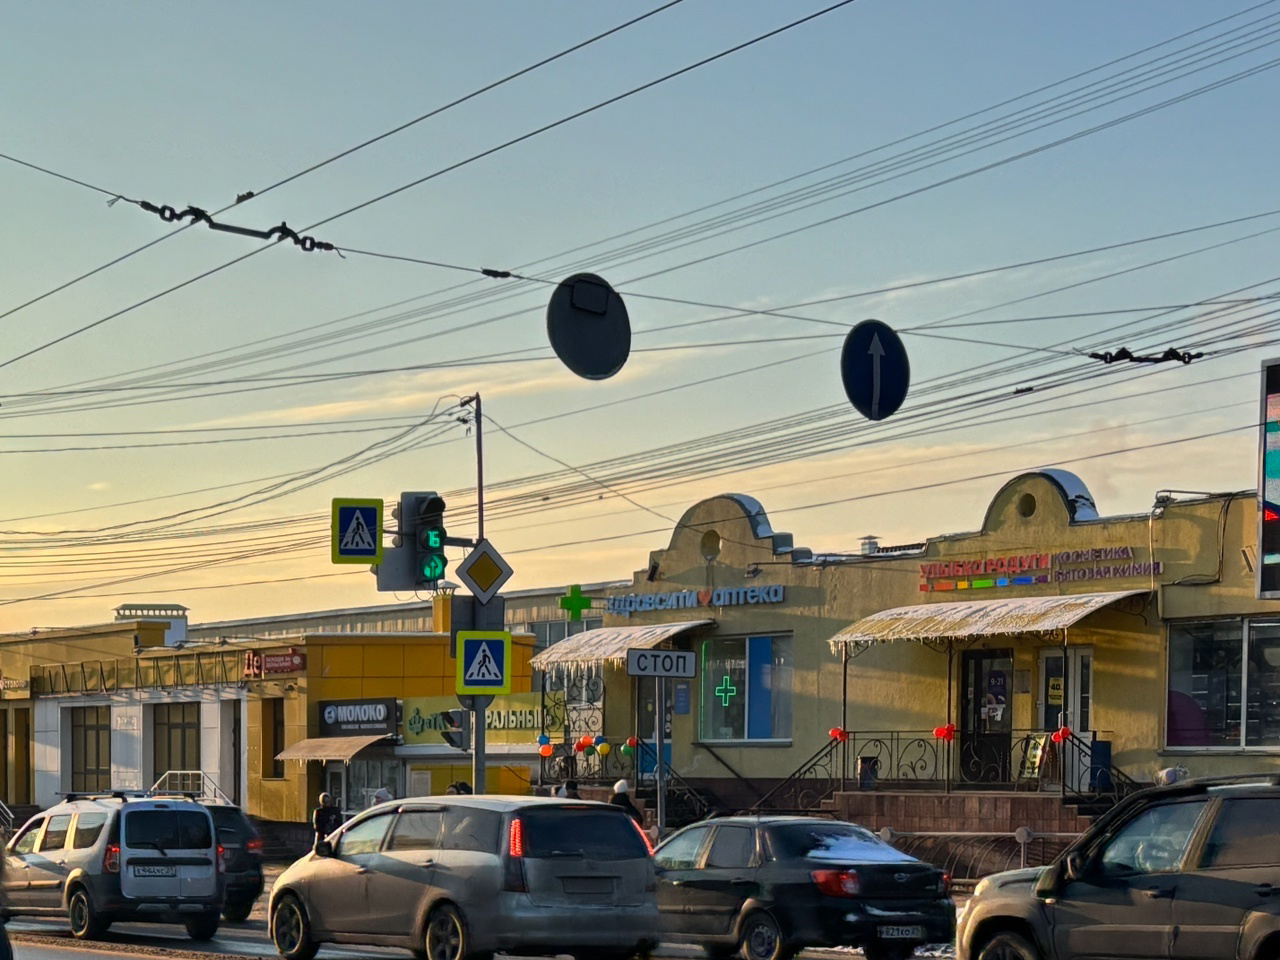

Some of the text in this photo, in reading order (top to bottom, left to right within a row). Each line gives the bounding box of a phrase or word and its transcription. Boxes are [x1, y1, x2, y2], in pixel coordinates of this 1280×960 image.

[1055, 546, 1133, 564] КОСМЕТИКА
[1055, 561, 1163, 582] БЫТОВАЯ ХИМИЯ
[713, 584, 786, 607] аптека
[637, 653, 687, 674] СТОП
[337, 704, 388, 722] МОЛОКО
